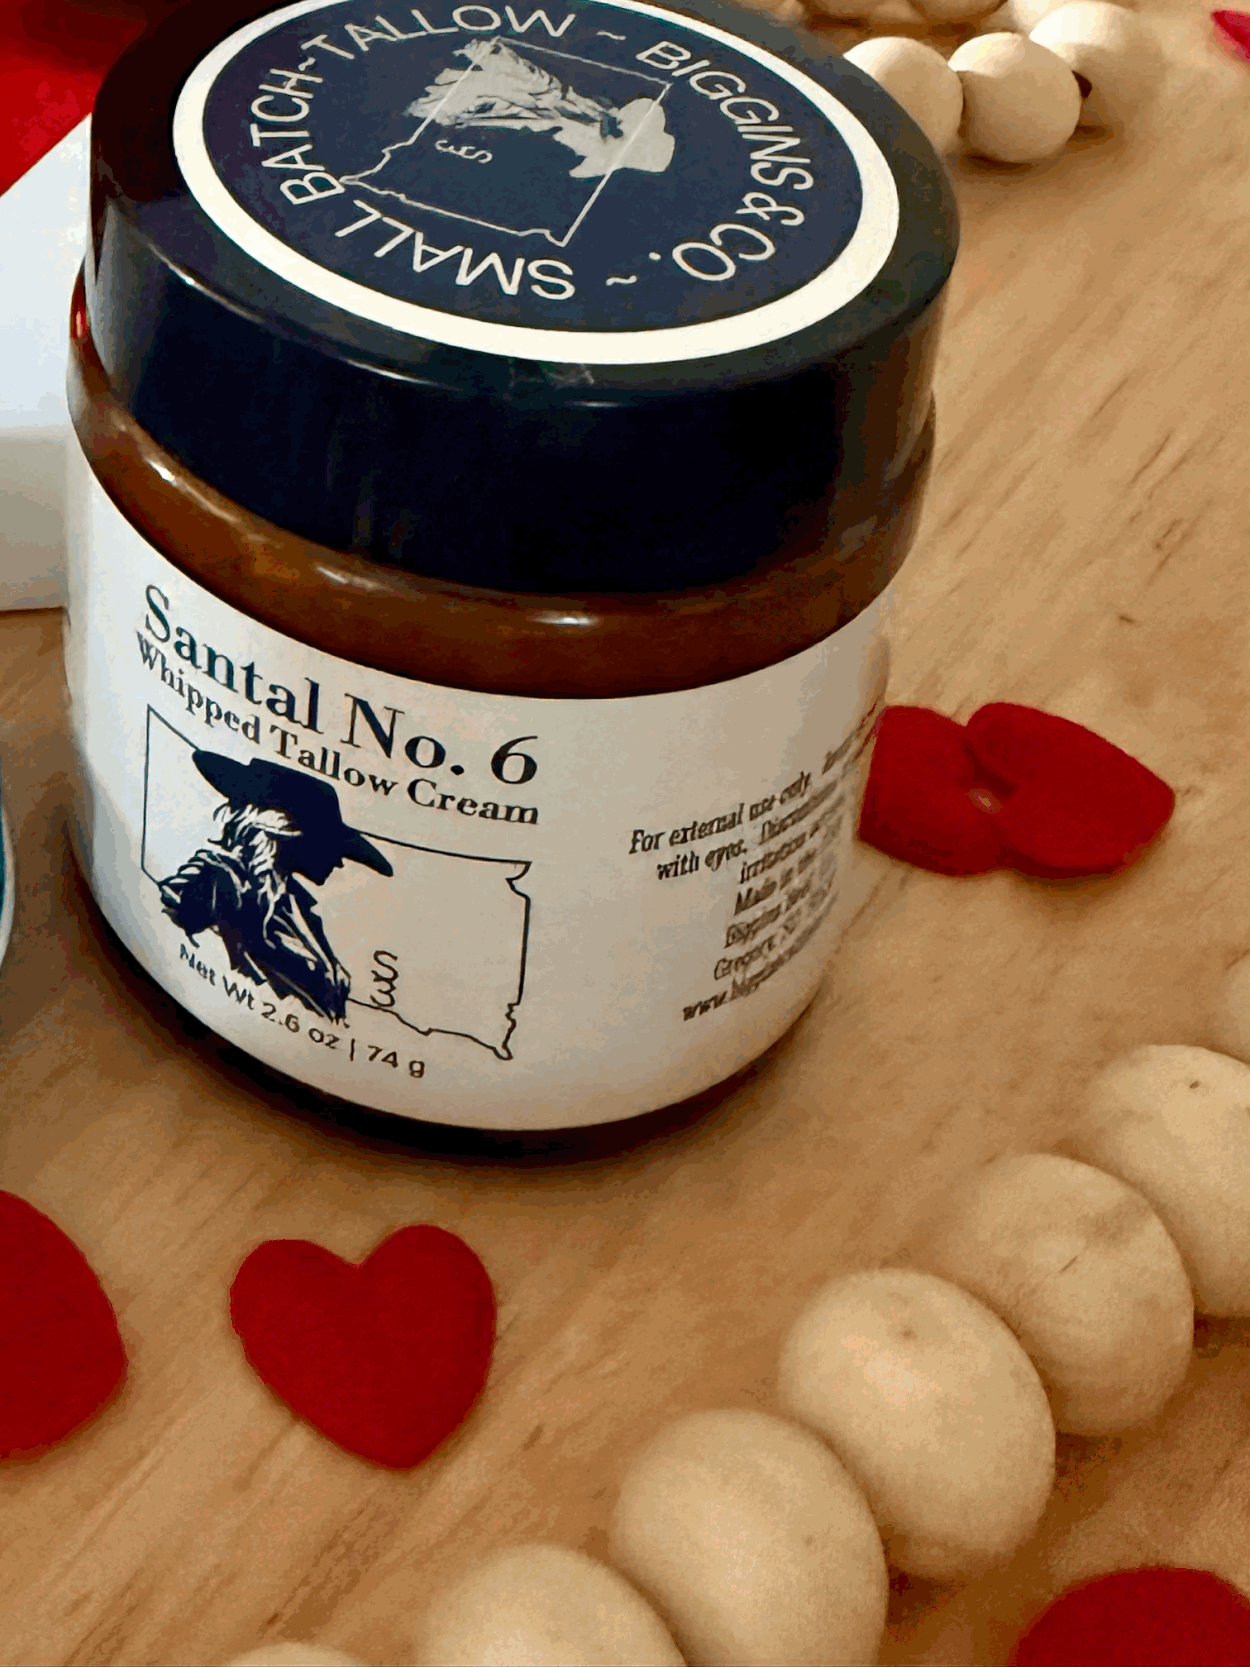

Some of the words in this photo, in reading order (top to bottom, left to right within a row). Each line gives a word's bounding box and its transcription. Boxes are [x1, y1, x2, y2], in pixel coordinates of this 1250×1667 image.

[335, 199, 575, 300] SMALL
[136, 630, 260, 745] Whipped
[269, 724, 399, 796] Tallow
[407, 777, 539, 825] Cream
[145, 584, 324, 734] Santal
[340, 692, 465, 776] No.
[491, 735, 538, 784] 6
[629, 829, 666, 855] For
[669, 802, 745, 847] external
[656, 850, 700, 880] with
[180, 943, 215, 986] Net
[223, 974, 255, 1010] Wt
[261, 1002, 300, 1033] 2.6
[308, 1028, 341, 1050] oz
[367, 1044, 399, 1069] 74
[408, 1060, 426, 1078] g
